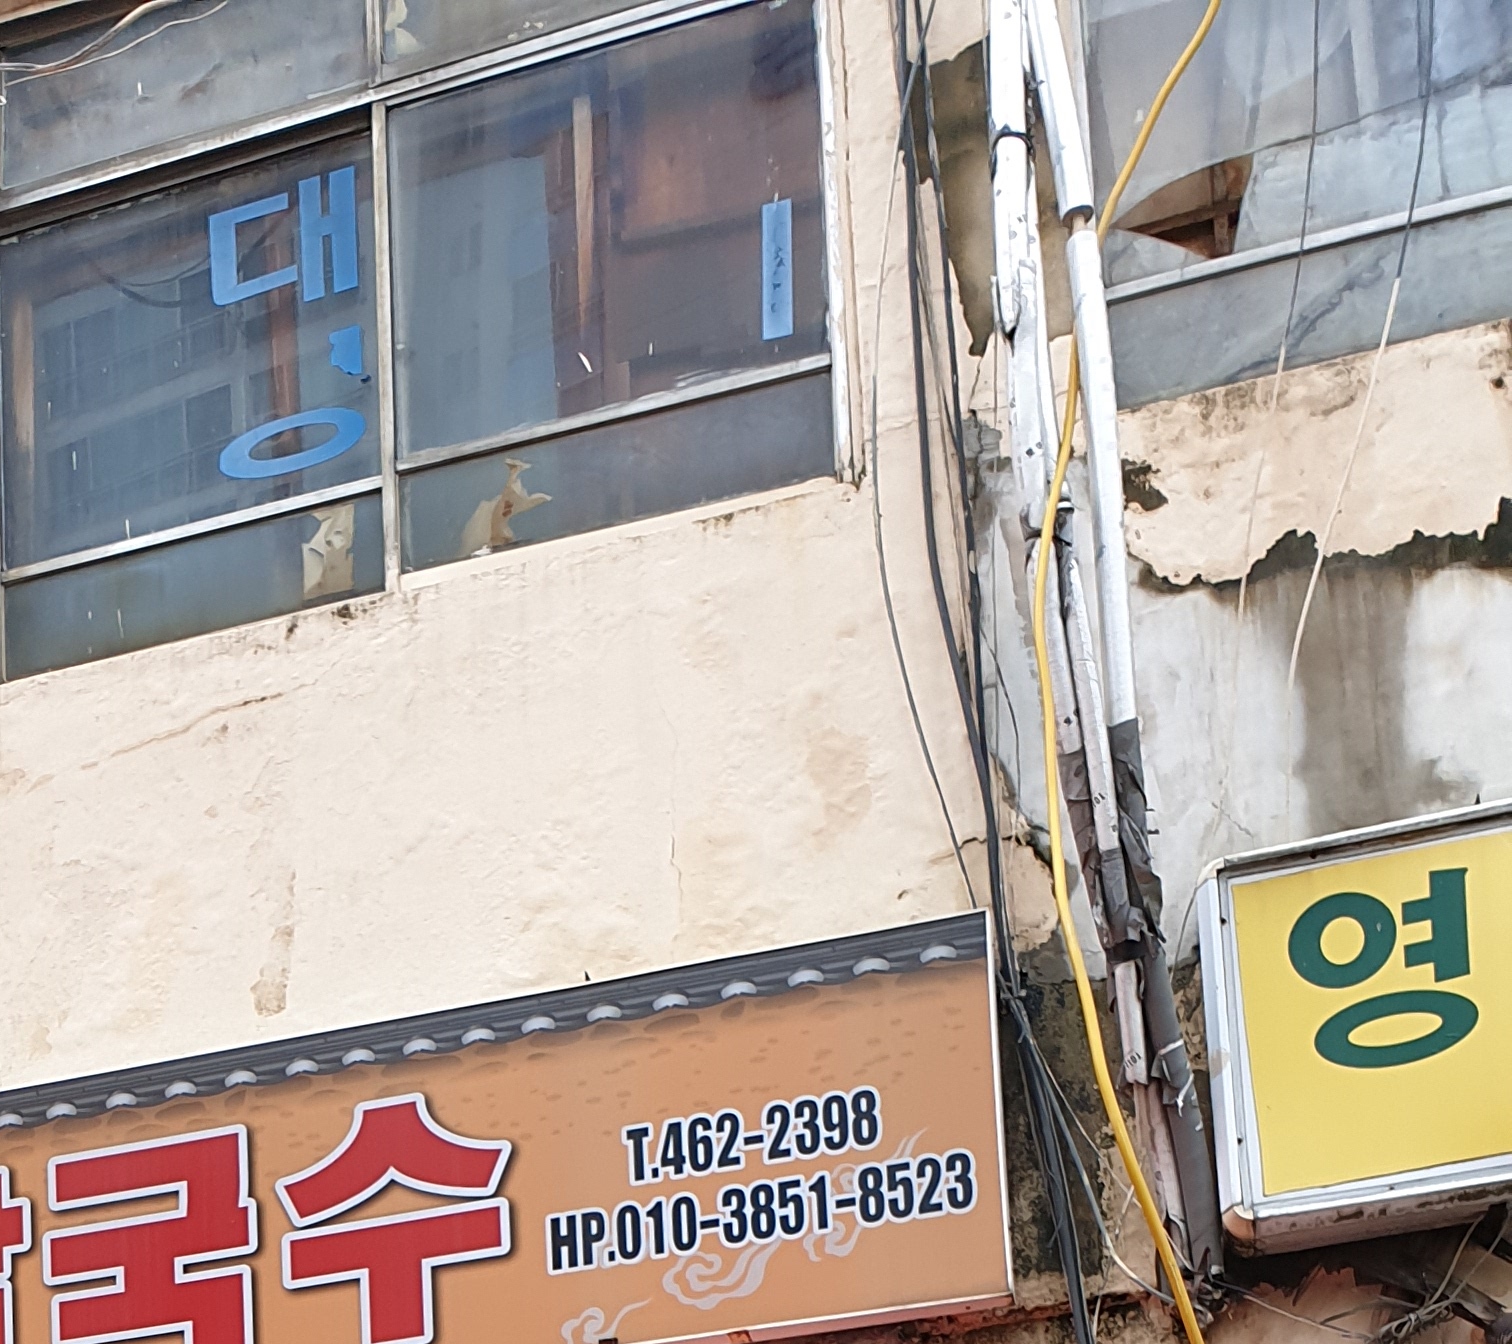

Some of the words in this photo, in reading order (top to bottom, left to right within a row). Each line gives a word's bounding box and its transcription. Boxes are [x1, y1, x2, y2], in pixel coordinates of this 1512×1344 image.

[1288, 867, 1479, 1068] 영
[624, 1087, 881, 1184] T.462-2398
[548, 1153, 974, 1272] HP.010-3851-8523
